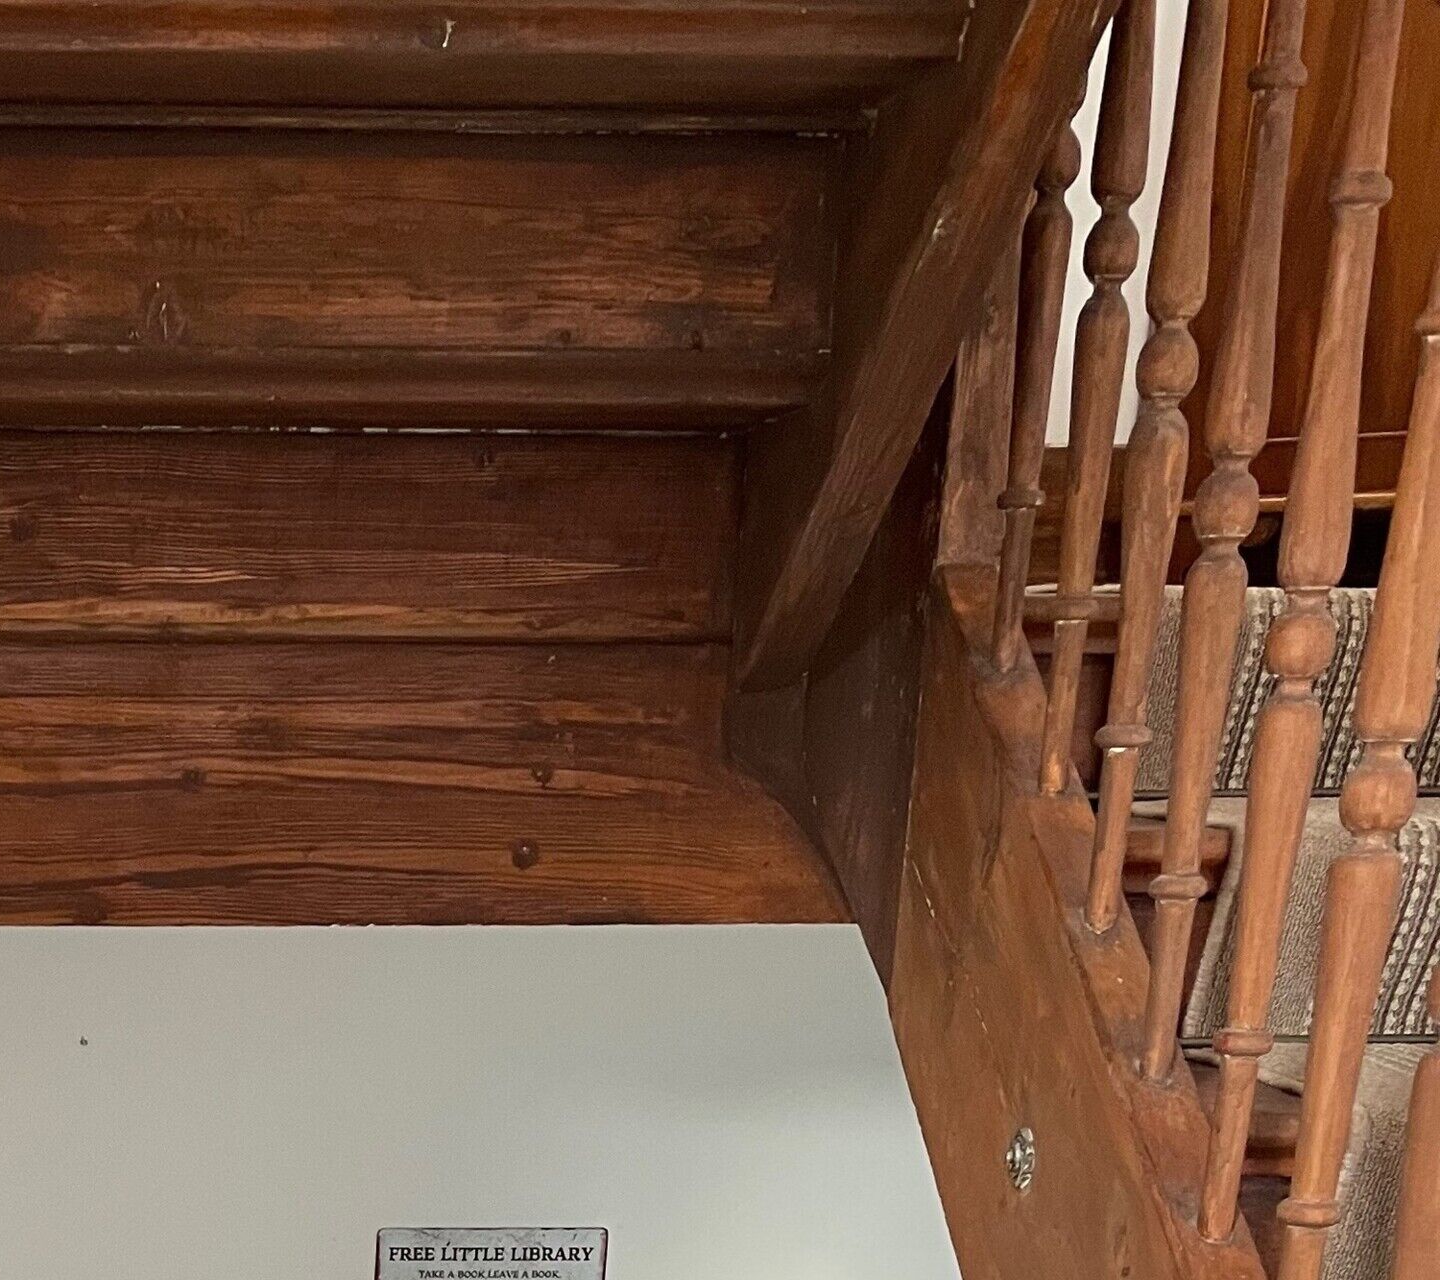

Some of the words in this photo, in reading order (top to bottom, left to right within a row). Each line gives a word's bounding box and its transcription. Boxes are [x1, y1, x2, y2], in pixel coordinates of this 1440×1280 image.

[388, 1246, 435, 1261] FREE
[441, 1246, 505, 1261] LITTLE
[511, 1247, 595, 1261] LIBRARY
[418, 1270, 445, 1279] TAKE
[447, 1270, 455, 1279] A
[488, 1270, 519, 1279] LEAVE
[521, 1270, 529, 1279] A
